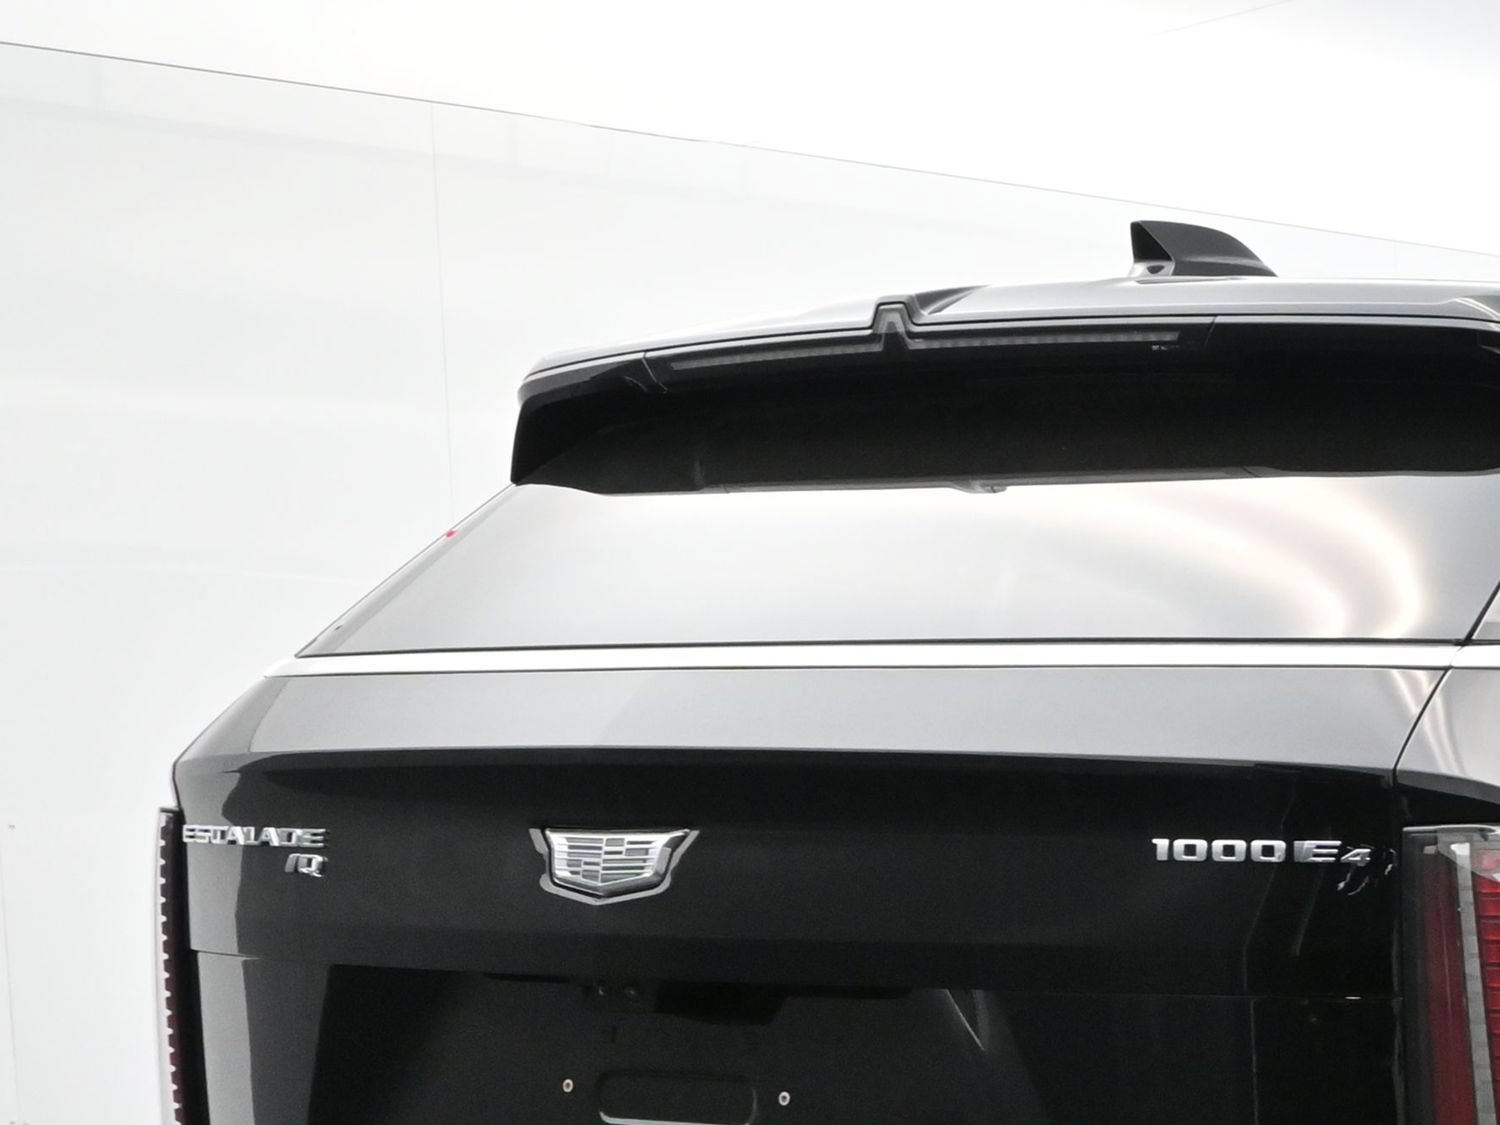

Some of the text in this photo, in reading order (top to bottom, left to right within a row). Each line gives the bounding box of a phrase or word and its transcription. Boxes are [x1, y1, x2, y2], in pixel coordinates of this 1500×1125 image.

[1152, 838, 1371, 865] 1000 E4
[284, 853, 325, 877] IQ
